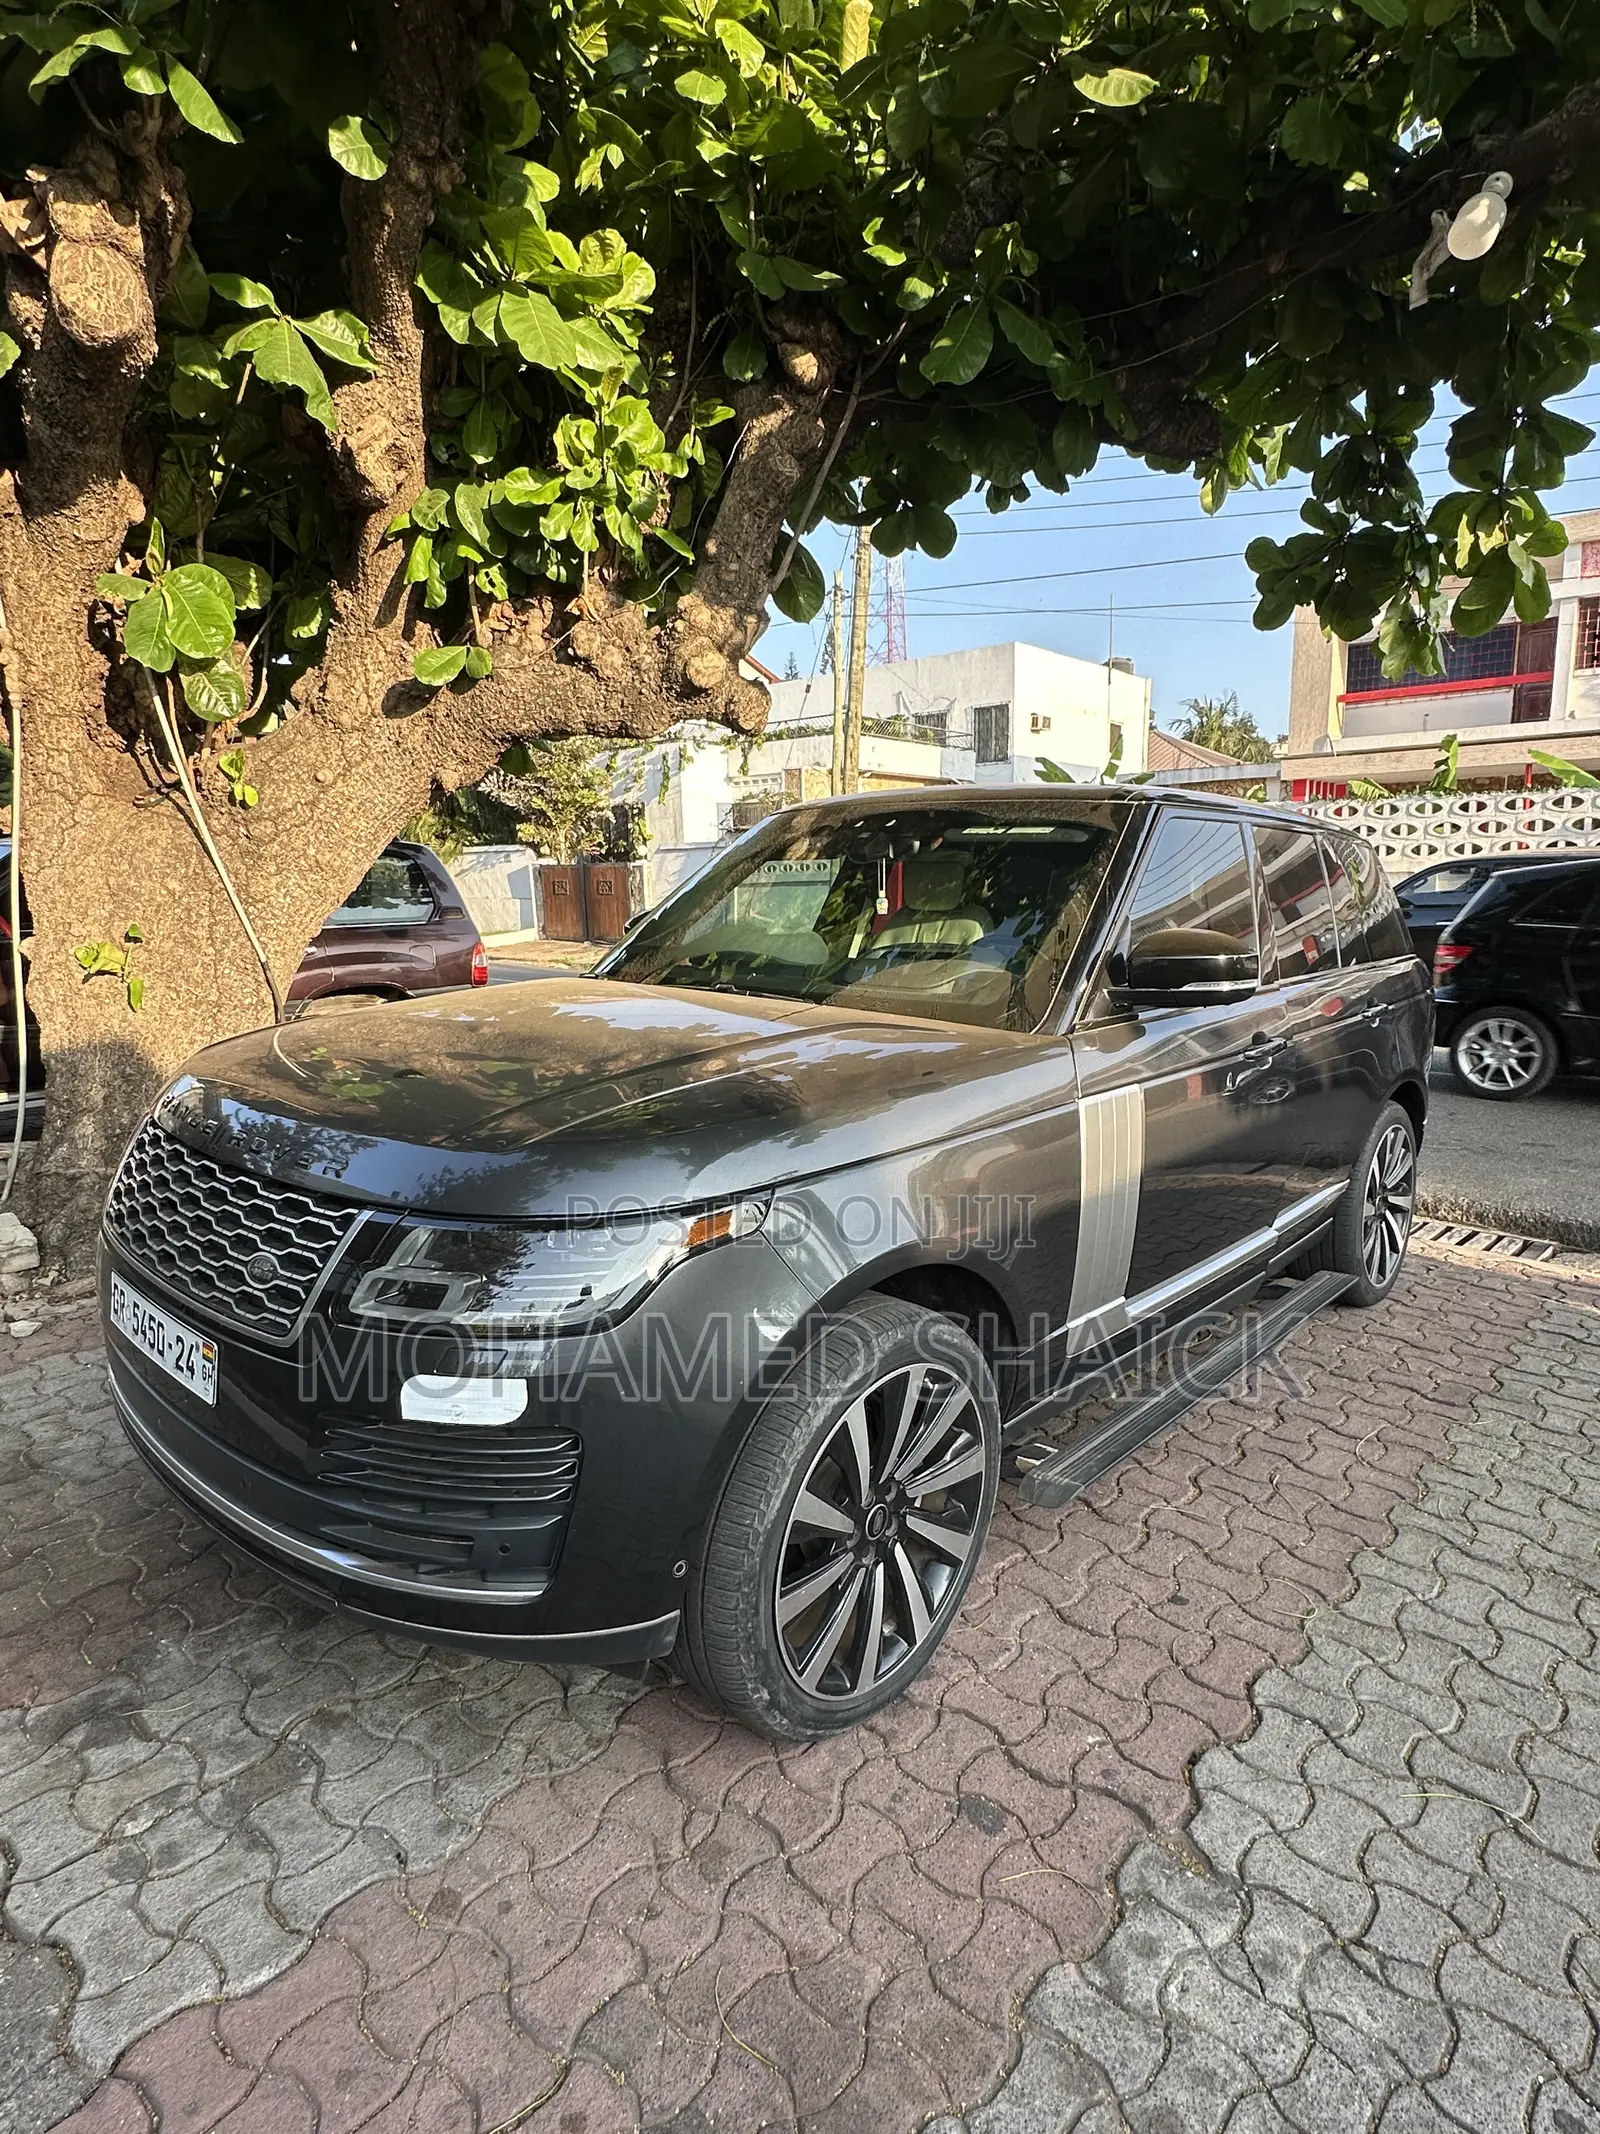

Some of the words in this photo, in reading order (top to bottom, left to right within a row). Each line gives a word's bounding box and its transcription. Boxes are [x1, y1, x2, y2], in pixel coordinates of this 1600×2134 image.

[228, 1129, 350, 1179] ROVER
[112, 1282, 127, 1323] GR
[201, 1363, 215, 1387] GH
